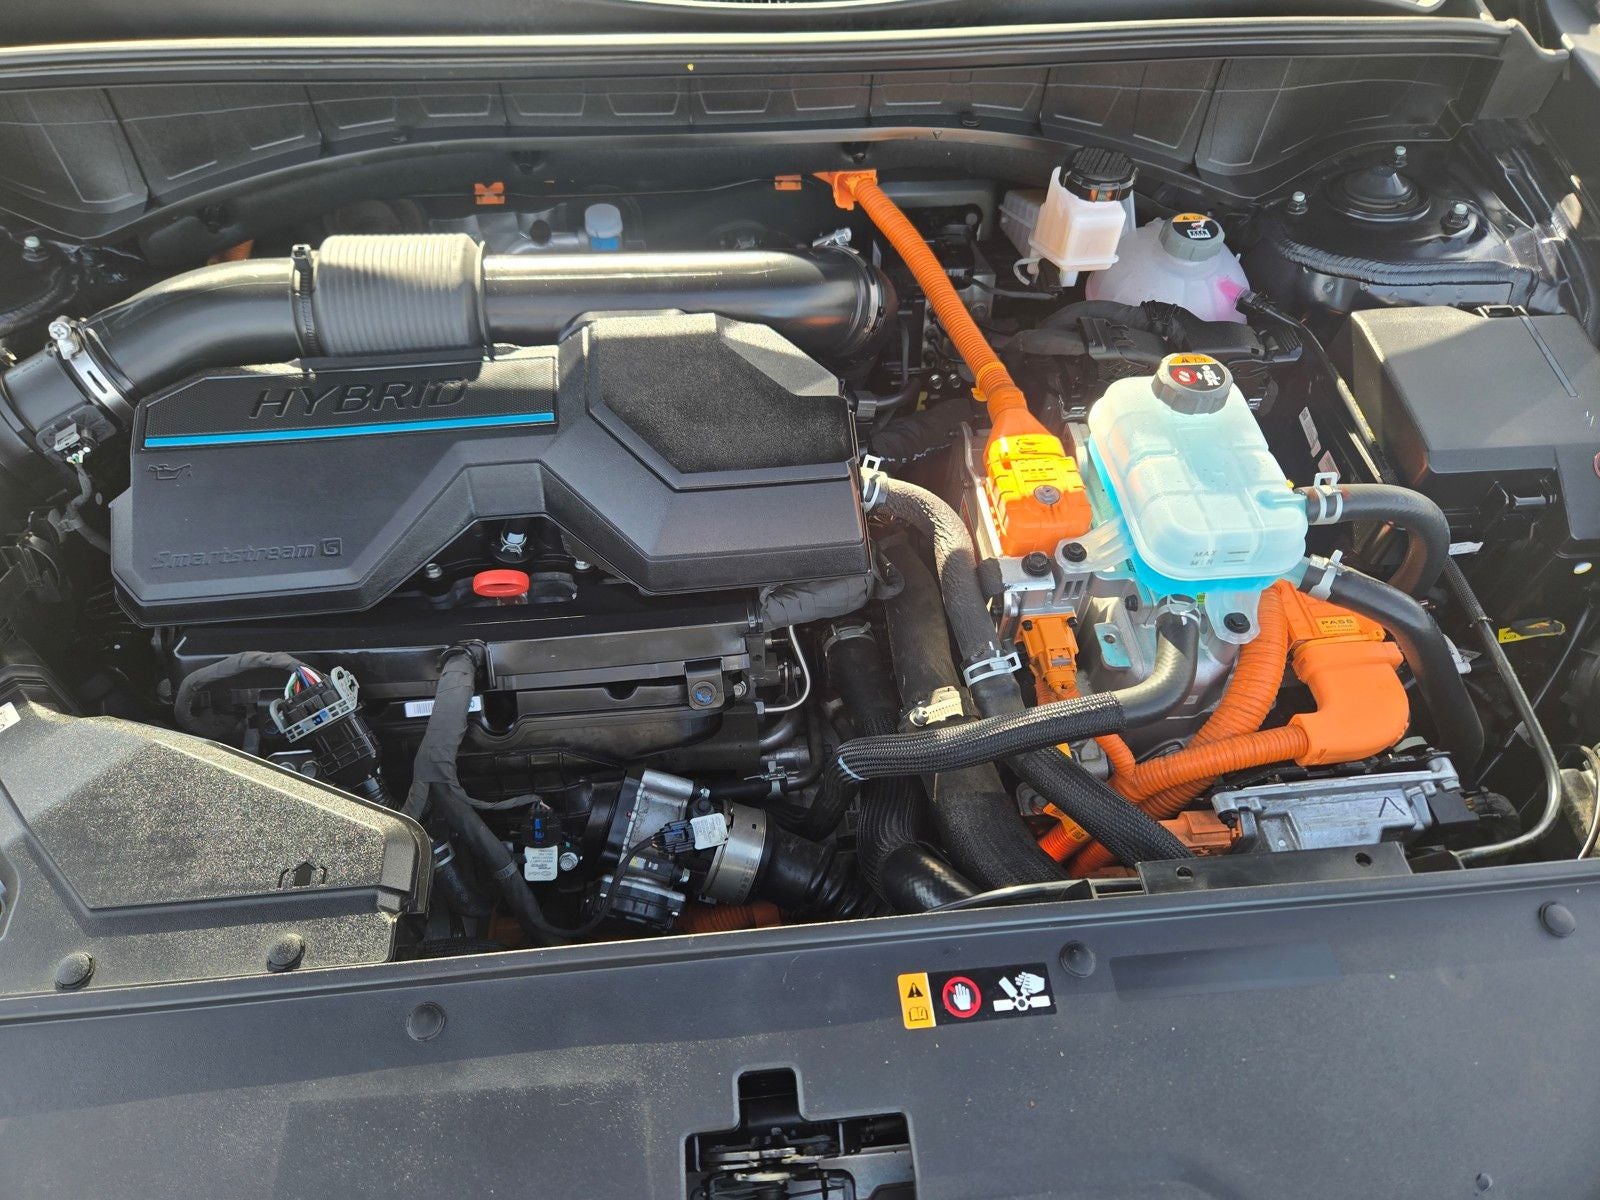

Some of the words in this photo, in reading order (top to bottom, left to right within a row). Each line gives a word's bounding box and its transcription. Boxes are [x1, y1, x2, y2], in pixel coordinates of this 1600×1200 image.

[249, 379, 467, 418] HYBRID
[151, 544, 317, 568] Smartstream
[1190, 559, 1214, 567] MIN
